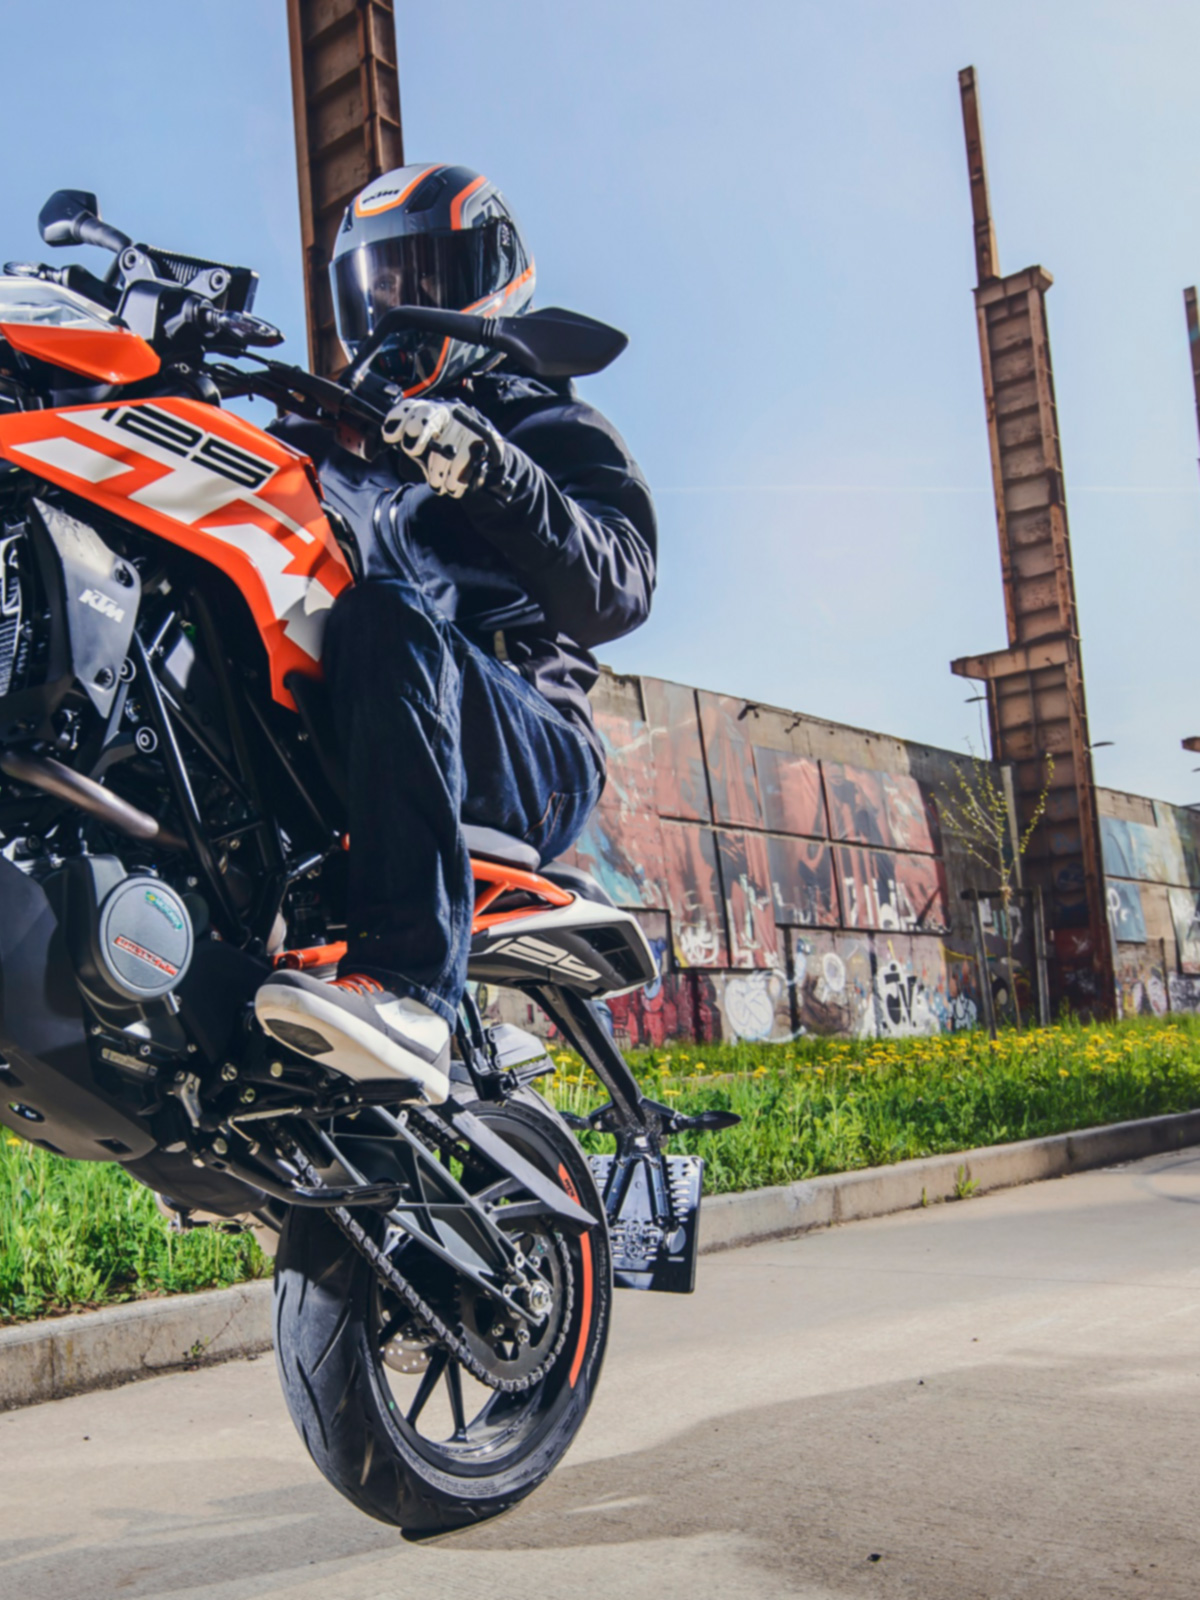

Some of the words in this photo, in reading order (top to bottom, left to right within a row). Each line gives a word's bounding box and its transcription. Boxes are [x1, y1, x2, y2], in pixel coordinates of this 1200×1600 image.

[101, 405, 275, 490] 125
[78, 588, 126, 624] KTM
[483, 935, 603, 981] 125
